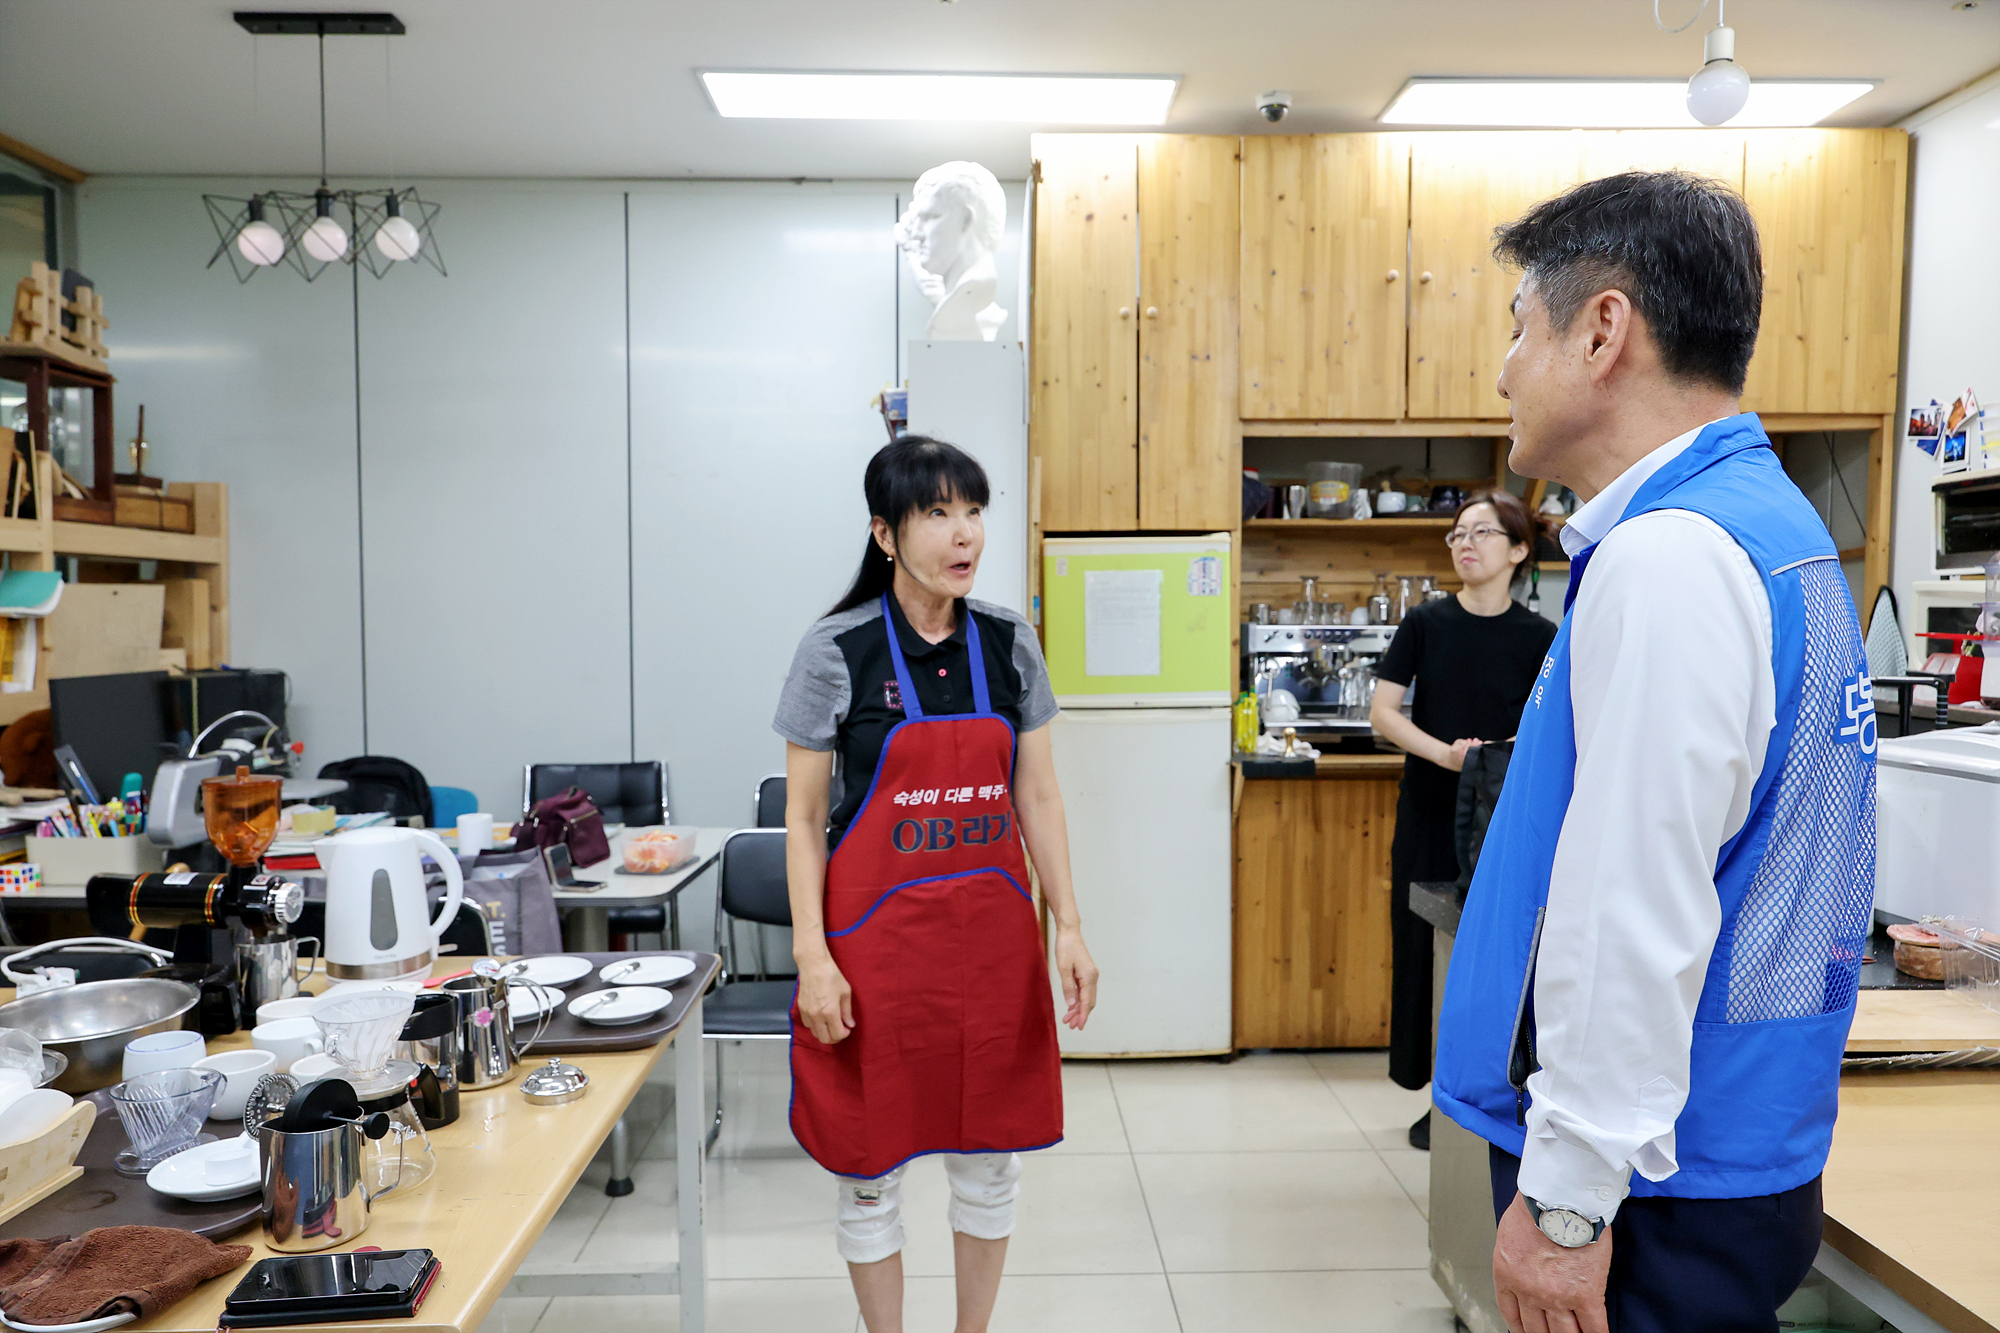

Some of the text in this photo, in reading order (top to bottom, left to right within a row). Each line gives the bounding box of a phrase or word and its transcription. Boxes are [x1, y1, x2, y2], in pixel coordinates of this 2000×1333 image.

[893, 788, 940, 806] 숙성이
[944, 786, 974, 803] 다른
[892, 810, 1011, 853] OB 라거
